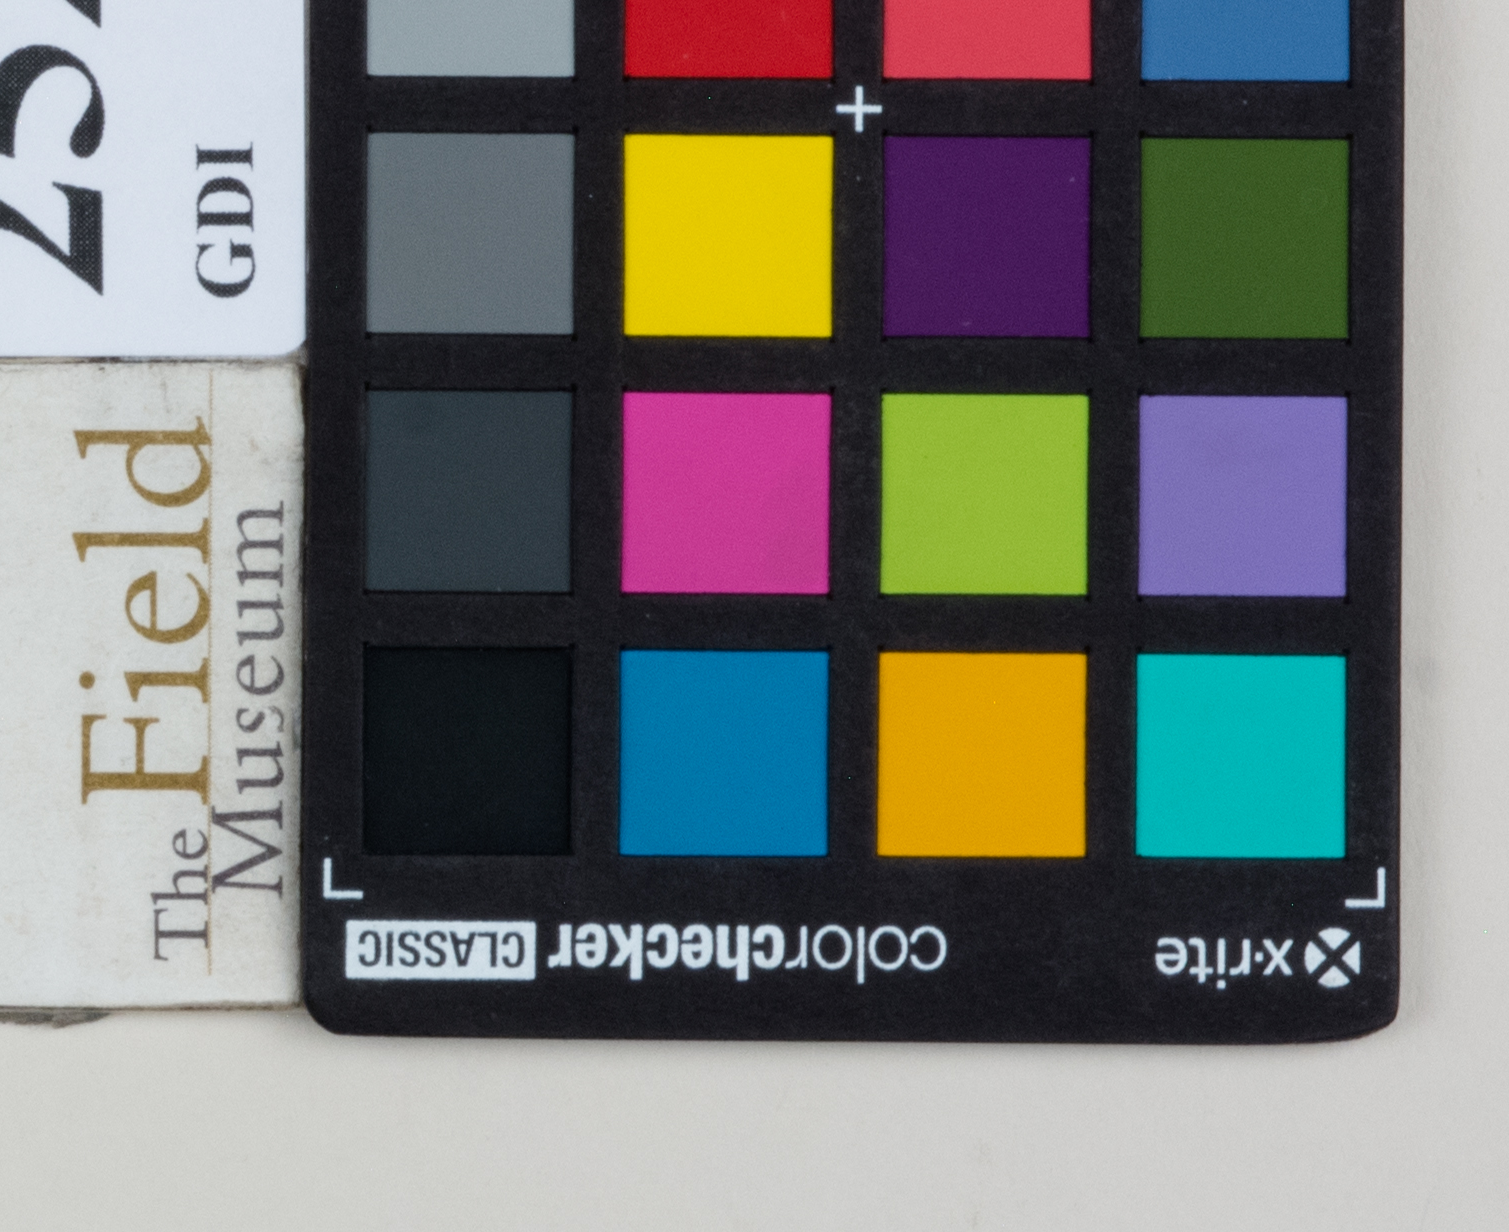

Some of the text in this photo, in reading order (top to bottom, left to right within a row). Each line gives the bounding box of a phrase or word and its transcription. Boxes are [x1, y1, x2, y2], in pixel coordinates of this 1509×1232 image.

[195, 147, 256, 298] GDI
[72, 415, 212, 961] The Field
[210, 500, 285, 899] Museum
[354, 922, 947, 981] colorchecker CLASSIC
